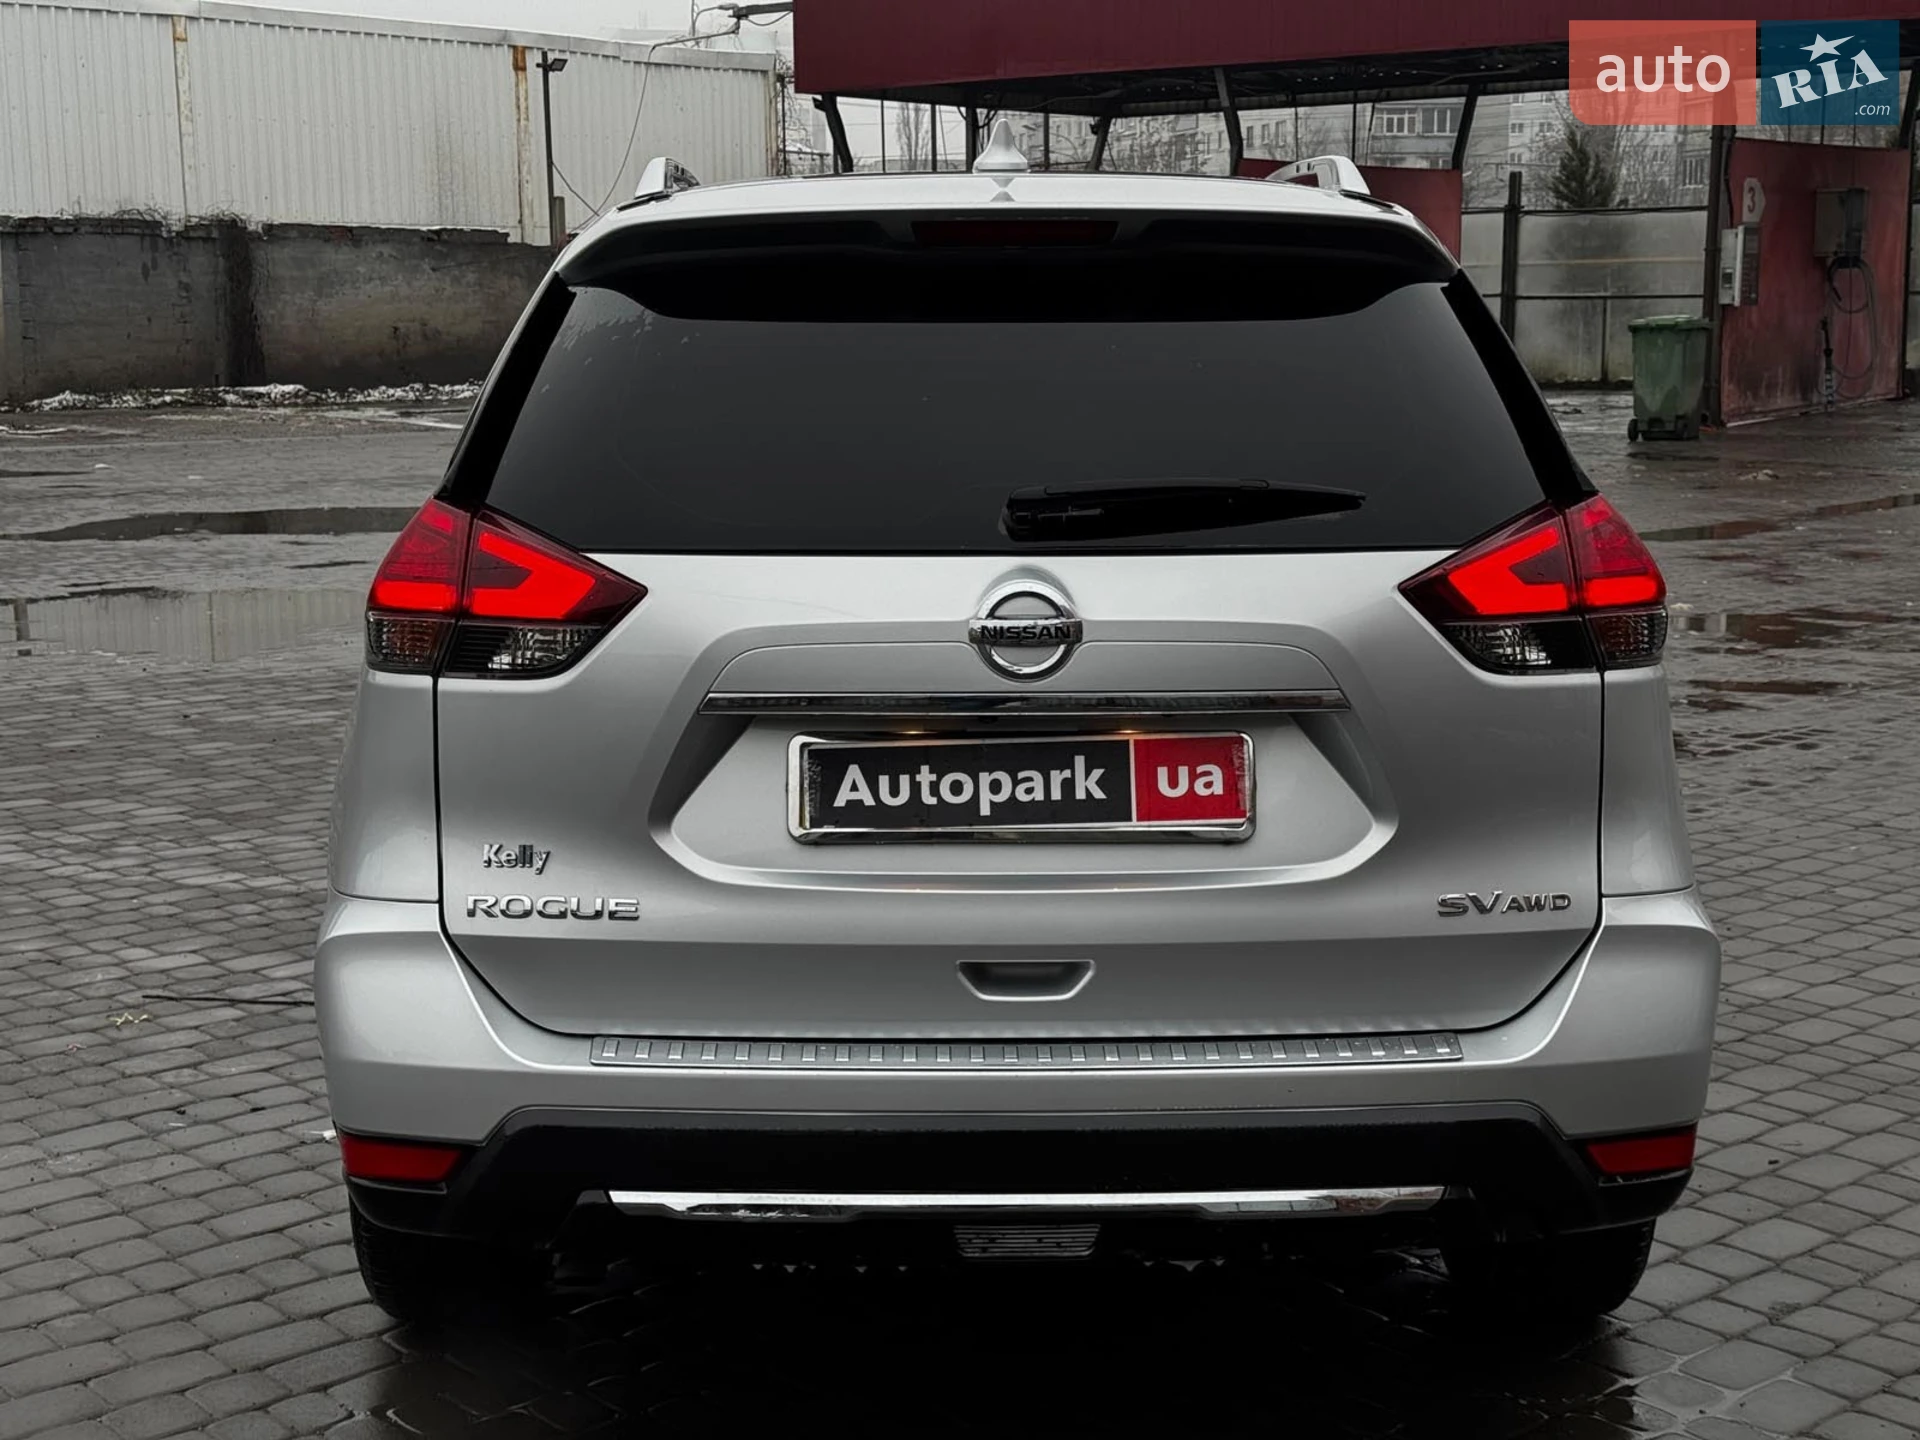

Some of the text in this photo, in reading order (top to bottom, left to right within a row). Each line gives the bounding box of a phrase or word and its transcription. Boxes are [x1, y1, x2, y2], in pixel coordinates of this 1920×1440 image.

[1747, 186, 1757, 214] 3
[980, 625, 1072, 640] NISSAN
[833, 755, 1107, 816] Autopark
[1156, 764, 1225, 798] ua
[483, 844, 551, 875] Kelly
[466, 895, 640, 921] ROGUE
